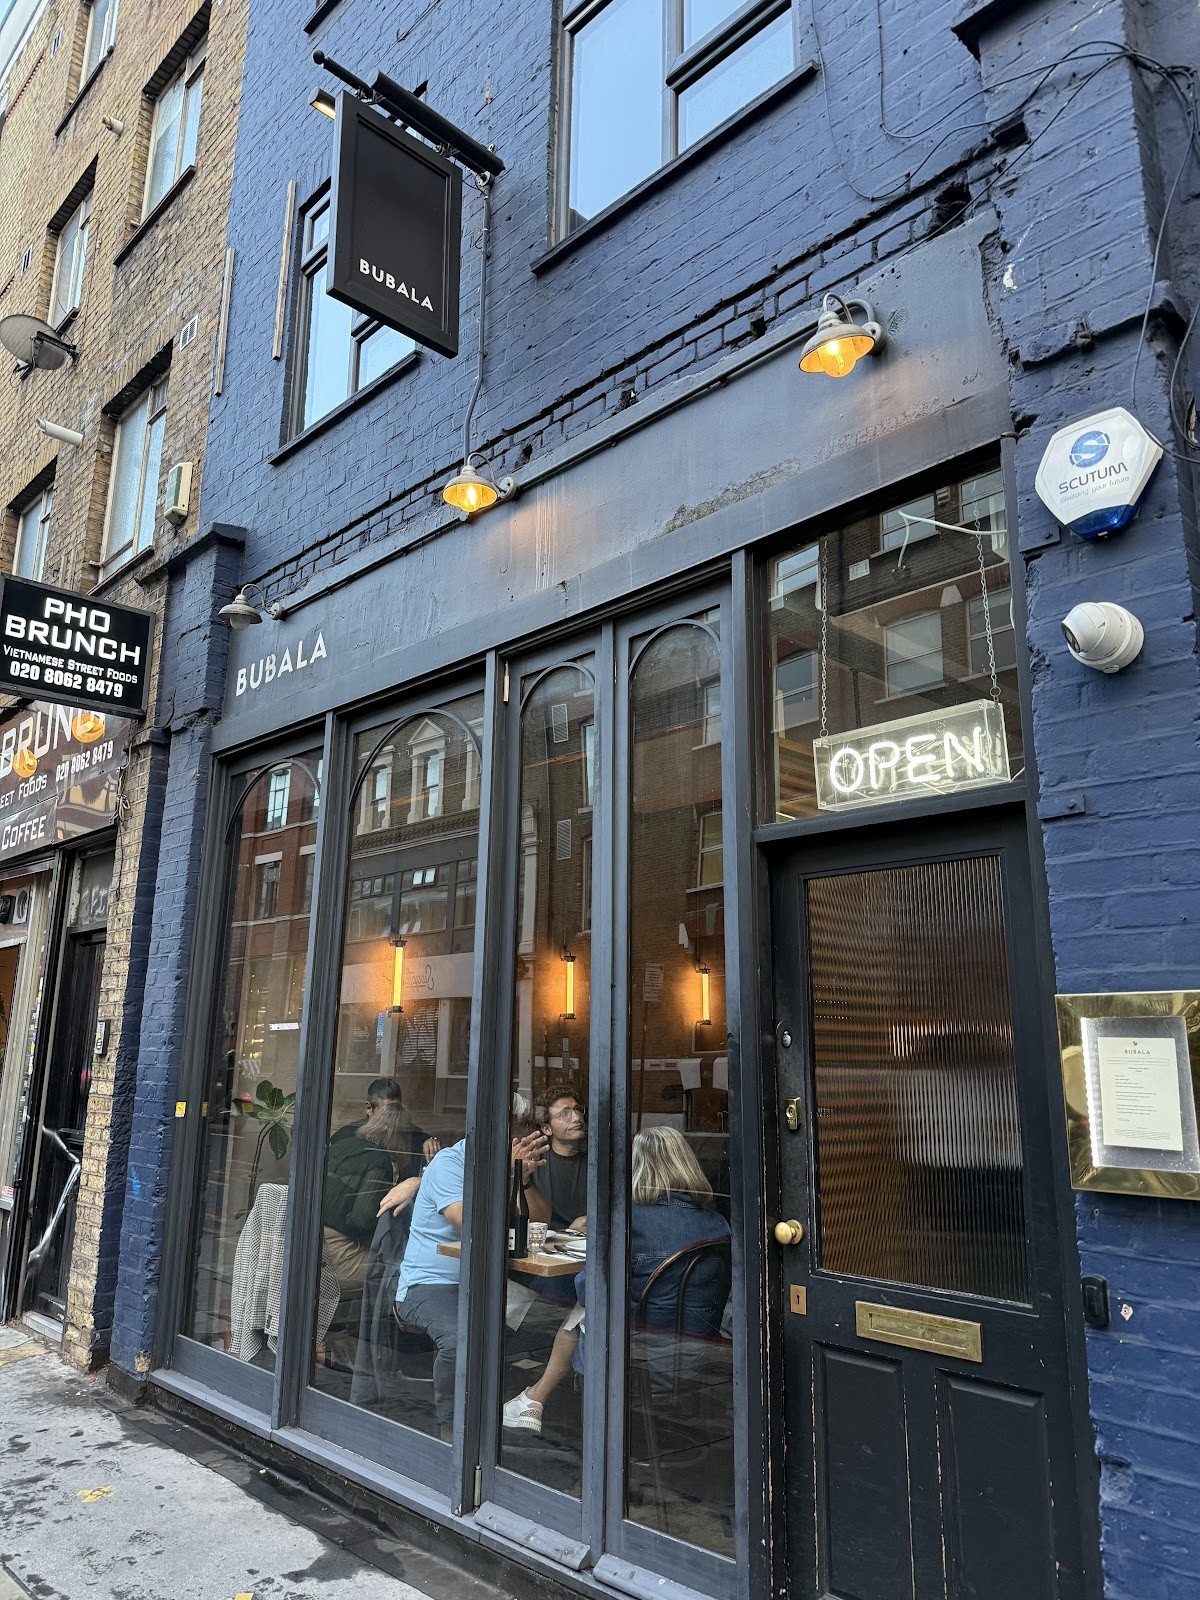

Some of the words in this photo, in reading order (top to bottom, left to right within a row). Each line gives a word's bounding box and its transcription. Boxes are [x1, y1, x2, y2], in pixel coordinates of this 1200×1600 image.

[360, 258, 434, 312] BUBALA
[1059, 462, 1128, 494] SCUTUM
[1091, 483, 1107, 493] your
[1109, 476, 1130, 487] future
[44, 597, 111, 633] PHO
[5, 614, 140, 666] BRUNCH
[3, 644, 64, 668] VIETNAMESE
[68, 659, 104, 677] STREET
[107, 668, 138, 684] FOODS
[10, 661, 40, 680] 020
[44, 668, 83, 689] 8062
[86, 677, 123, 698] 8479
[236, 632, 327, 697] BUBALA
[56, 760, 70, 782] 020
[71, 750, 91, 774] 8062
[92, 740, 113, 765] 8479
[829, 726, 985, 793] OPEN
[0, 790, 15, 809] EET
[2, 815, 47, 851] COFFEE
